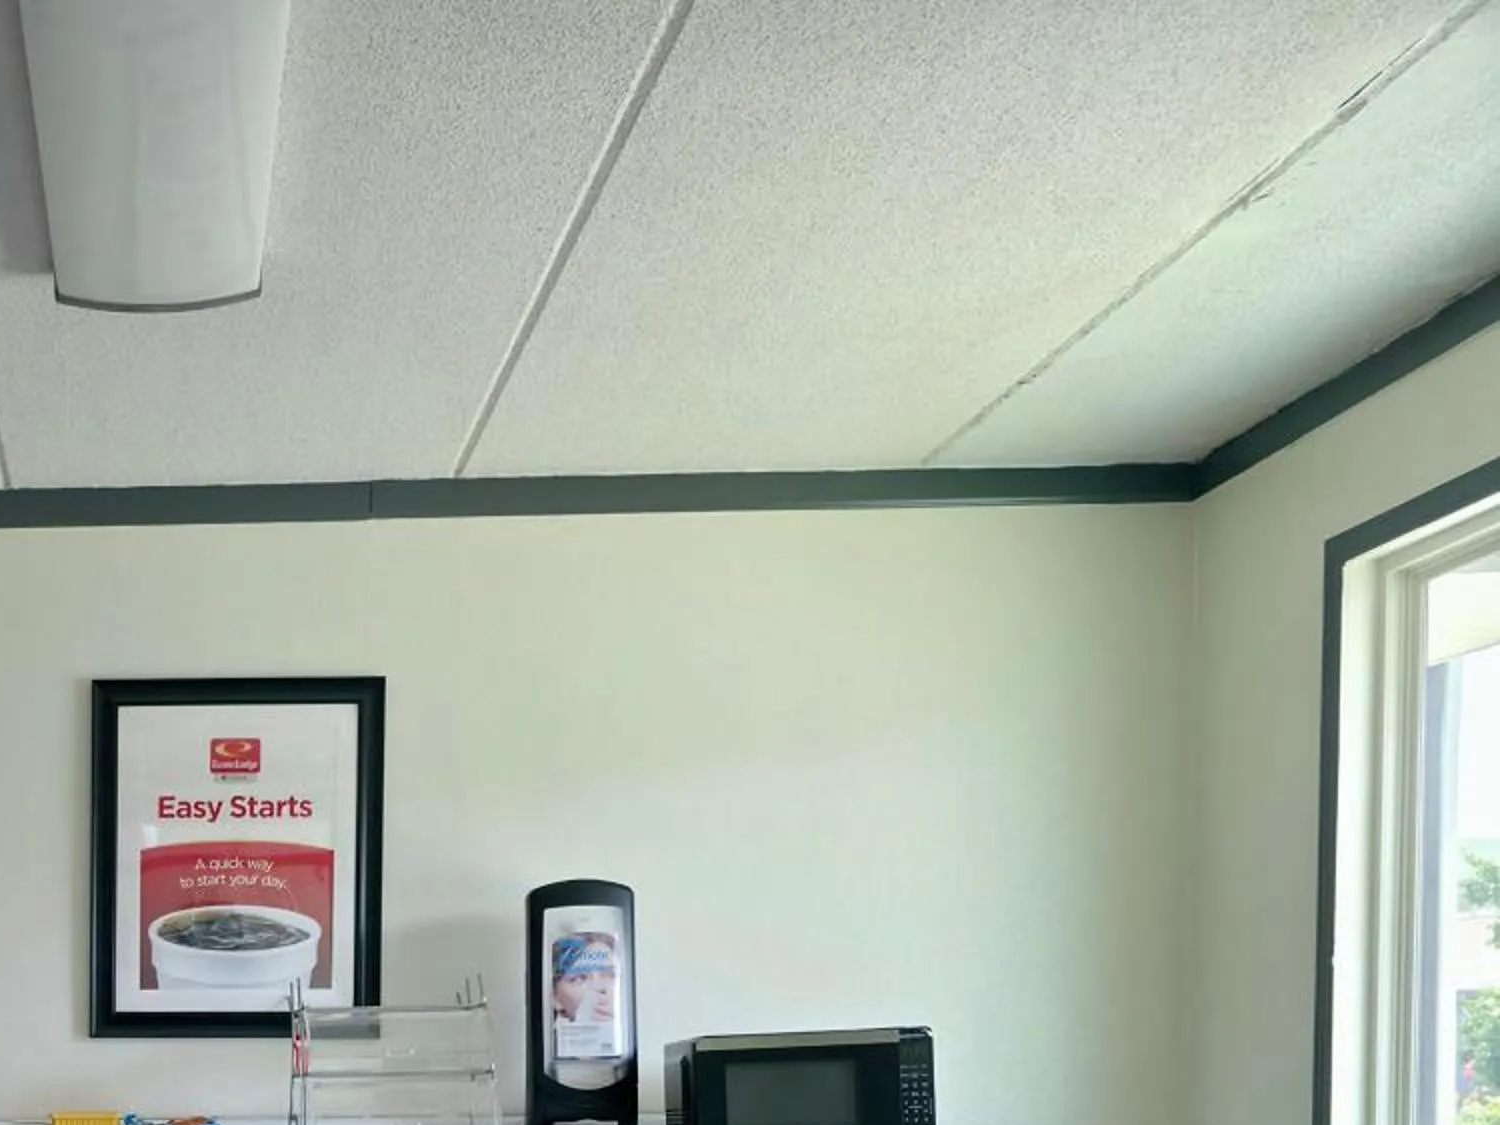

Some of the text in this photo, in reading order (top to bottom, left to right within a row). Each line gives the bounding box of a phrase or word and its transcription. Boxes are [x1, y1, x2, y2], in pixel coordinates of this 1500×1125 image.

[157, 795, 313, 823] Easy Starts
[195, 856, 275, 872] A quick way
[179, 876, 195, 889] to
[197, 875, 226, 887] start
[229, 875, 258, 887] your
